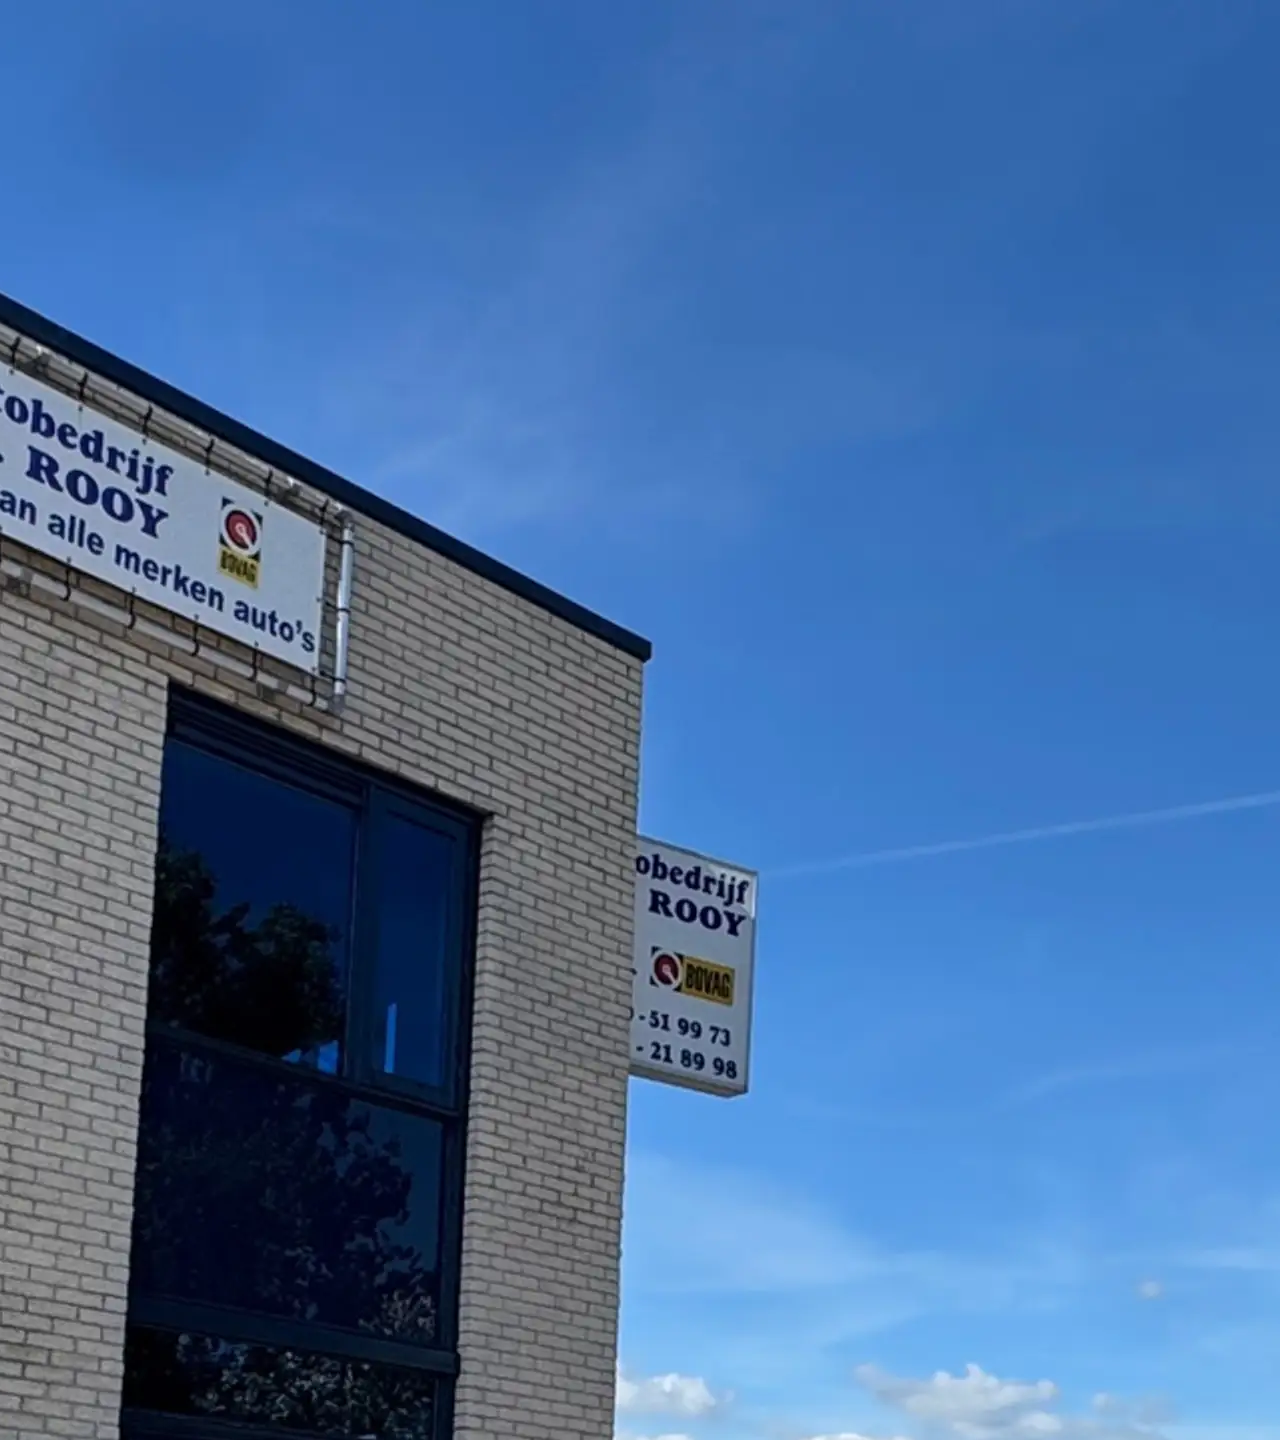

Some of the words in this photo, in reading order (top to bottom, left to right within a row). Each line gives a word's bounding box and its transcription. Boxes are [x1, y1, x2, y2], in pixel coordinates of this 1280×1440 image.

[25, 445, 169, 538] ROOY
[47, 513, 105, 556] alle
[115, 543, 224, 612] merken
[233, 599, 316, 653] auto's
[648, 888, 746, 937] ROOY
[685, 962, 731, 1000] BOVAG
[677, 1017, 702, 1039] 99
[709, 1025, 731, 1047] 73
[650, 1041, 673, 1064] 21
[680, 1048, 705, 1072] 89
[712, 1056, 737, 1080] 98
